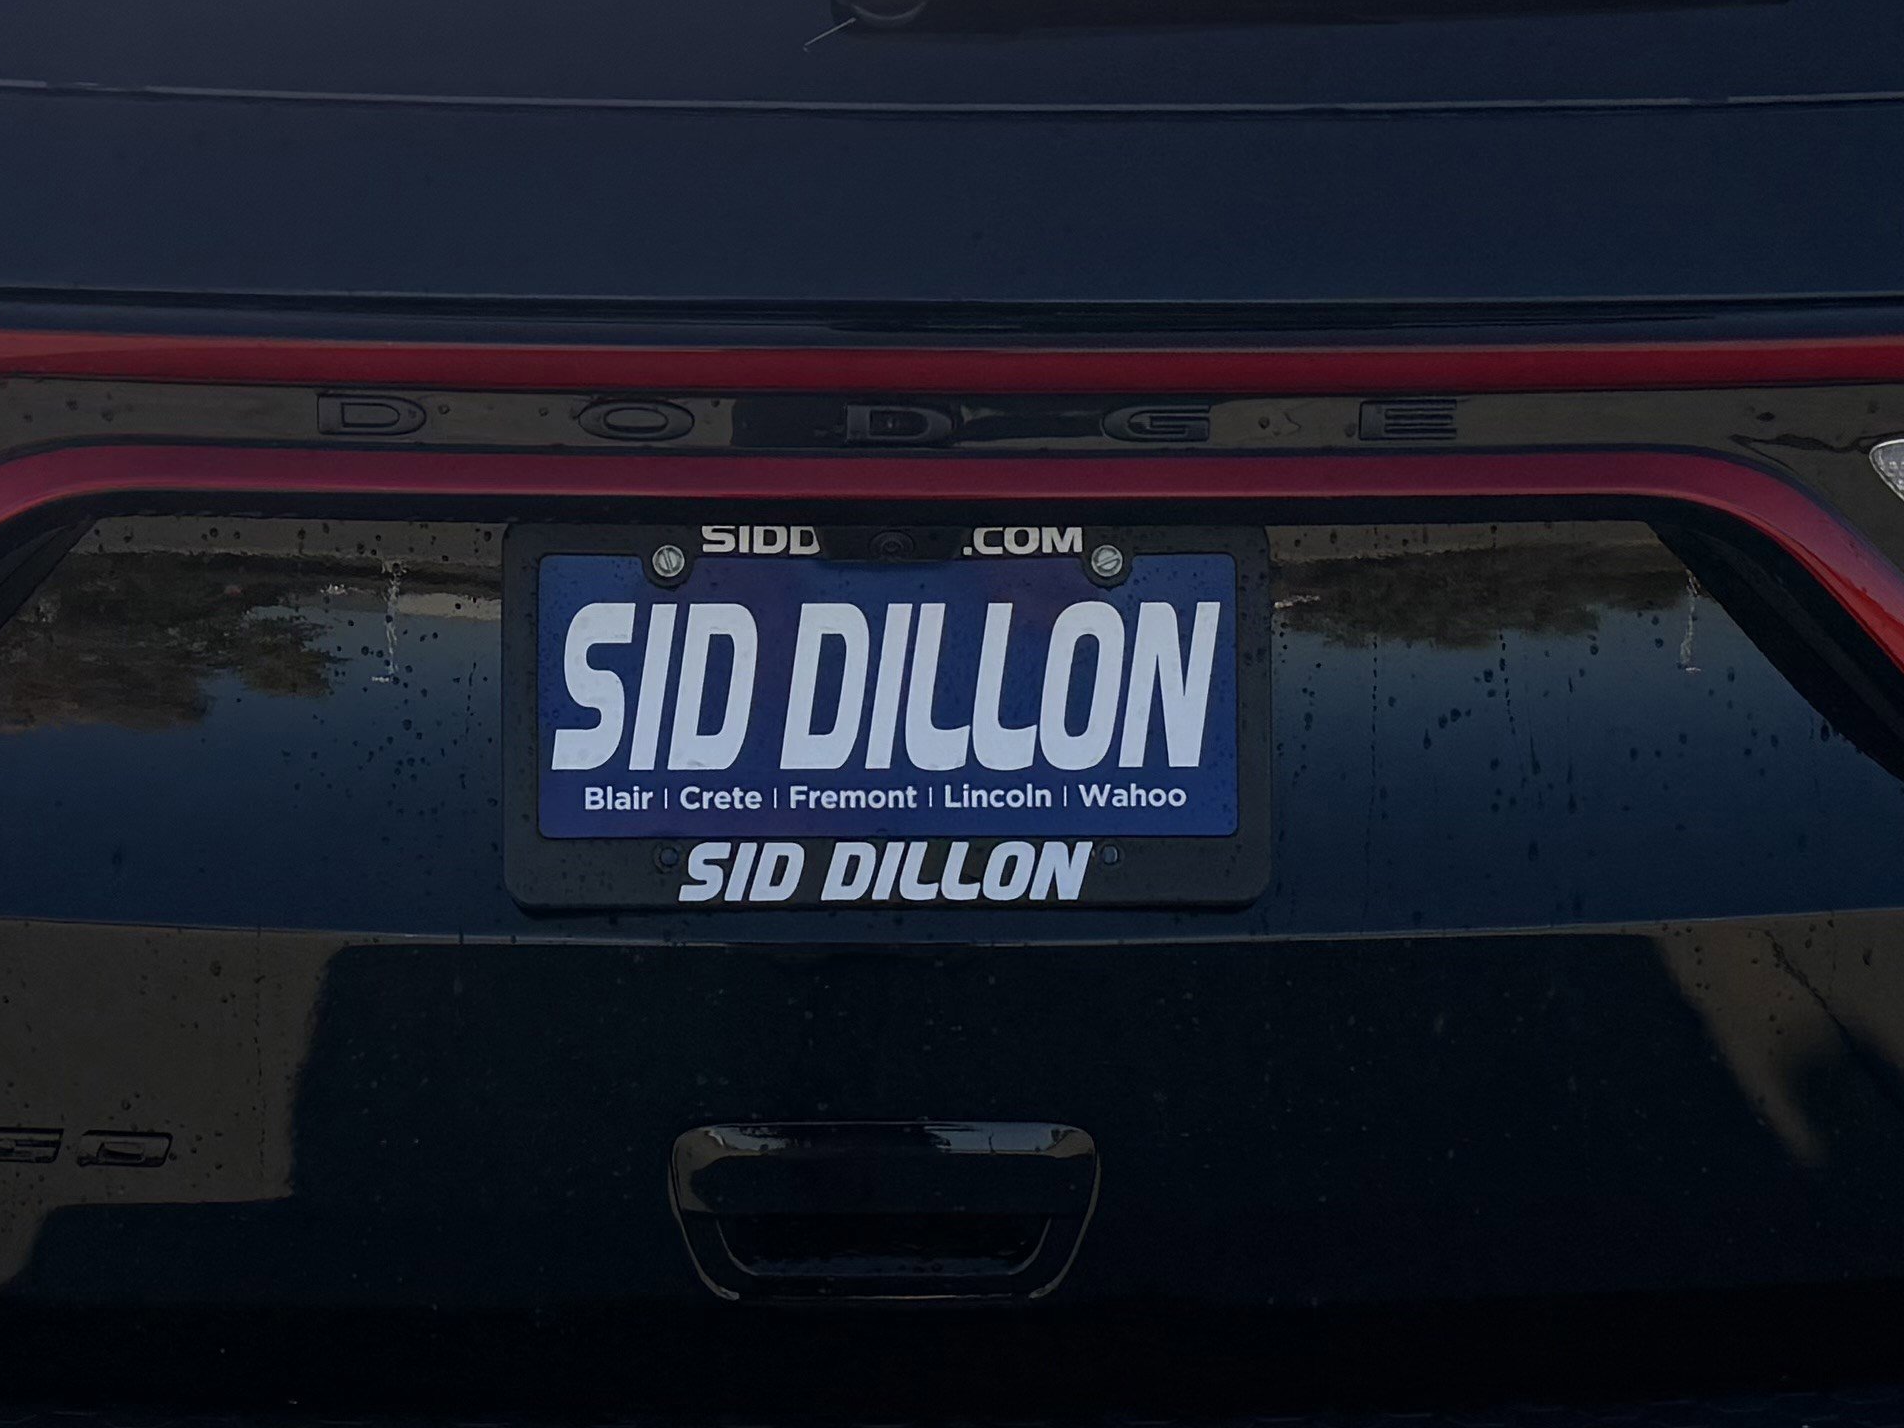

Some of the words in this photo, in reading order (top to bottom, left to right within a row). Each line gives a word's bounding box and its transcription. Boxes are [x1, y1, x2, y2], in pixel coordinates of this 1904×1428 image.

[316, 394, 1459, 447] DODGE
[551, 602, 759, 771] SID
[779, 600, 1222, 771] DILLON
[585, 785, 654, 811] Blair
[680, 786, 763, 810] Crete
[789, 785, 918, 810] Fremont
[943, 783, 1053, 809] Lincoln
[1077, 783, 1188, 808] Wahoo
[678, 842, 805, 902] SID
[820, 841, 1094, 902] DILLON
